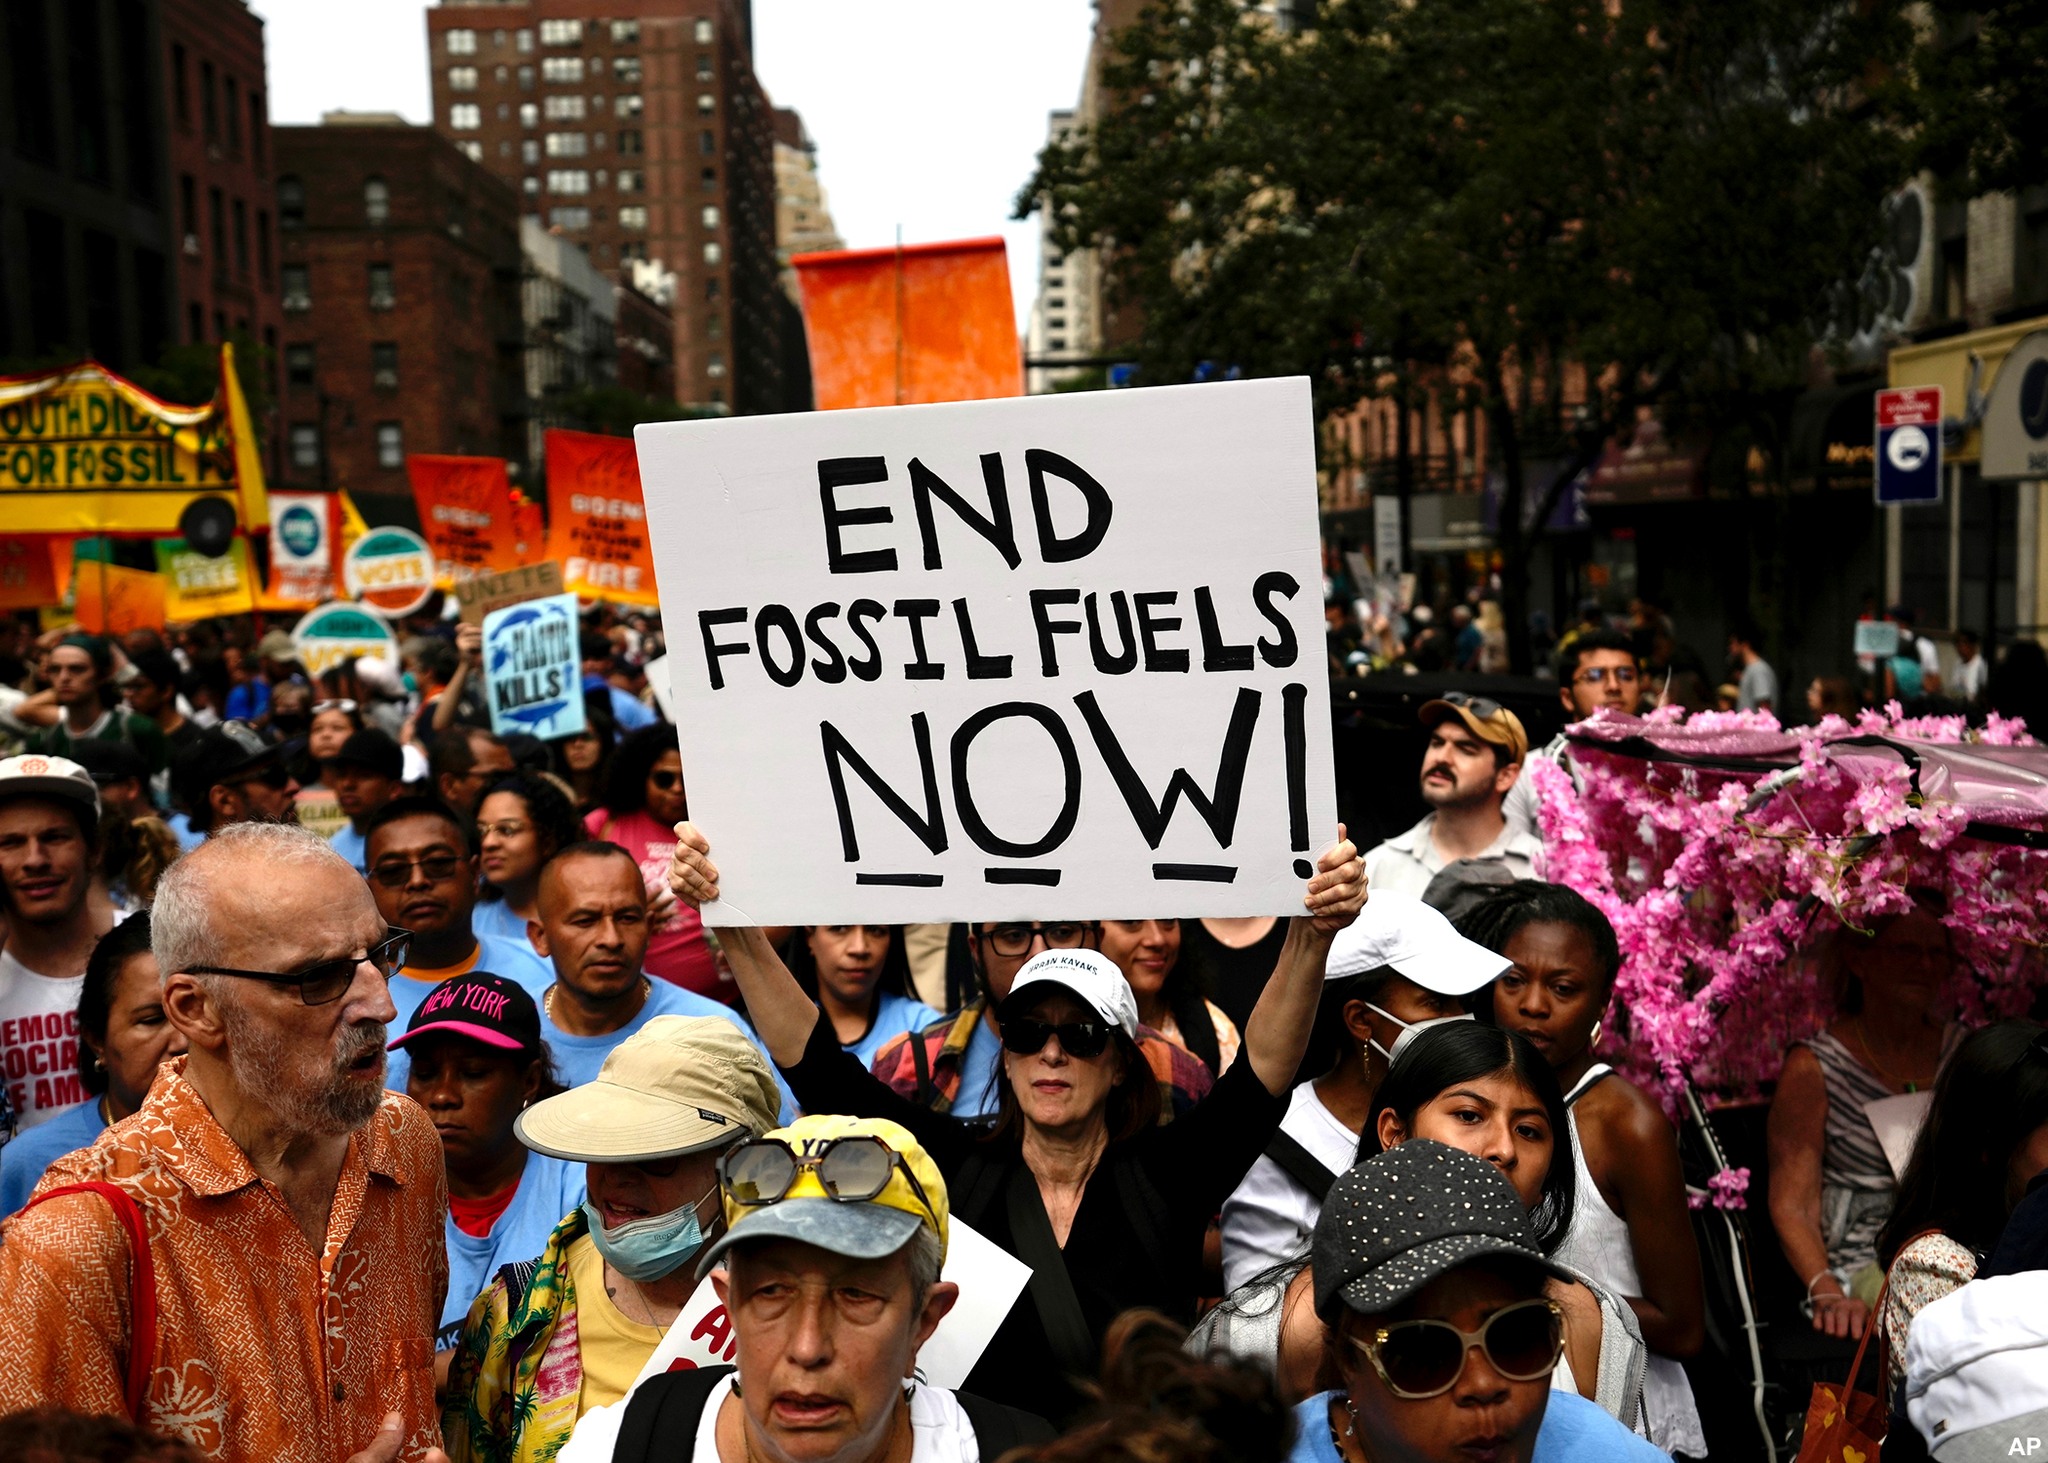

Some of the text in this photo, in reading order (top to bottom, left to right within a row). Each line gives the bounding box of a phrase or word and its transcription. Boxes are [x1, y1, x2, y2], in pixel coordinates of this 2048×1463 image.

[66, 446, 184, 483] FOSSIL
[818, 449, 1112, 574] END
[354, 557, 423, 585] VOTE
[564, 556, 642, 592] FIRE
[698, 572, 1300, 690] FOSSIL FUELS
[494, 668, 561, 711] KILLS
[820, 682, 1314, 880] NOW!
[420, 982, 511, 1022] NEW YORK
[0, 1009, 81, 1048] EMOC
[0, 1039, 79, 1081] OCIA
[35, 1073, 93, 1110] AM
